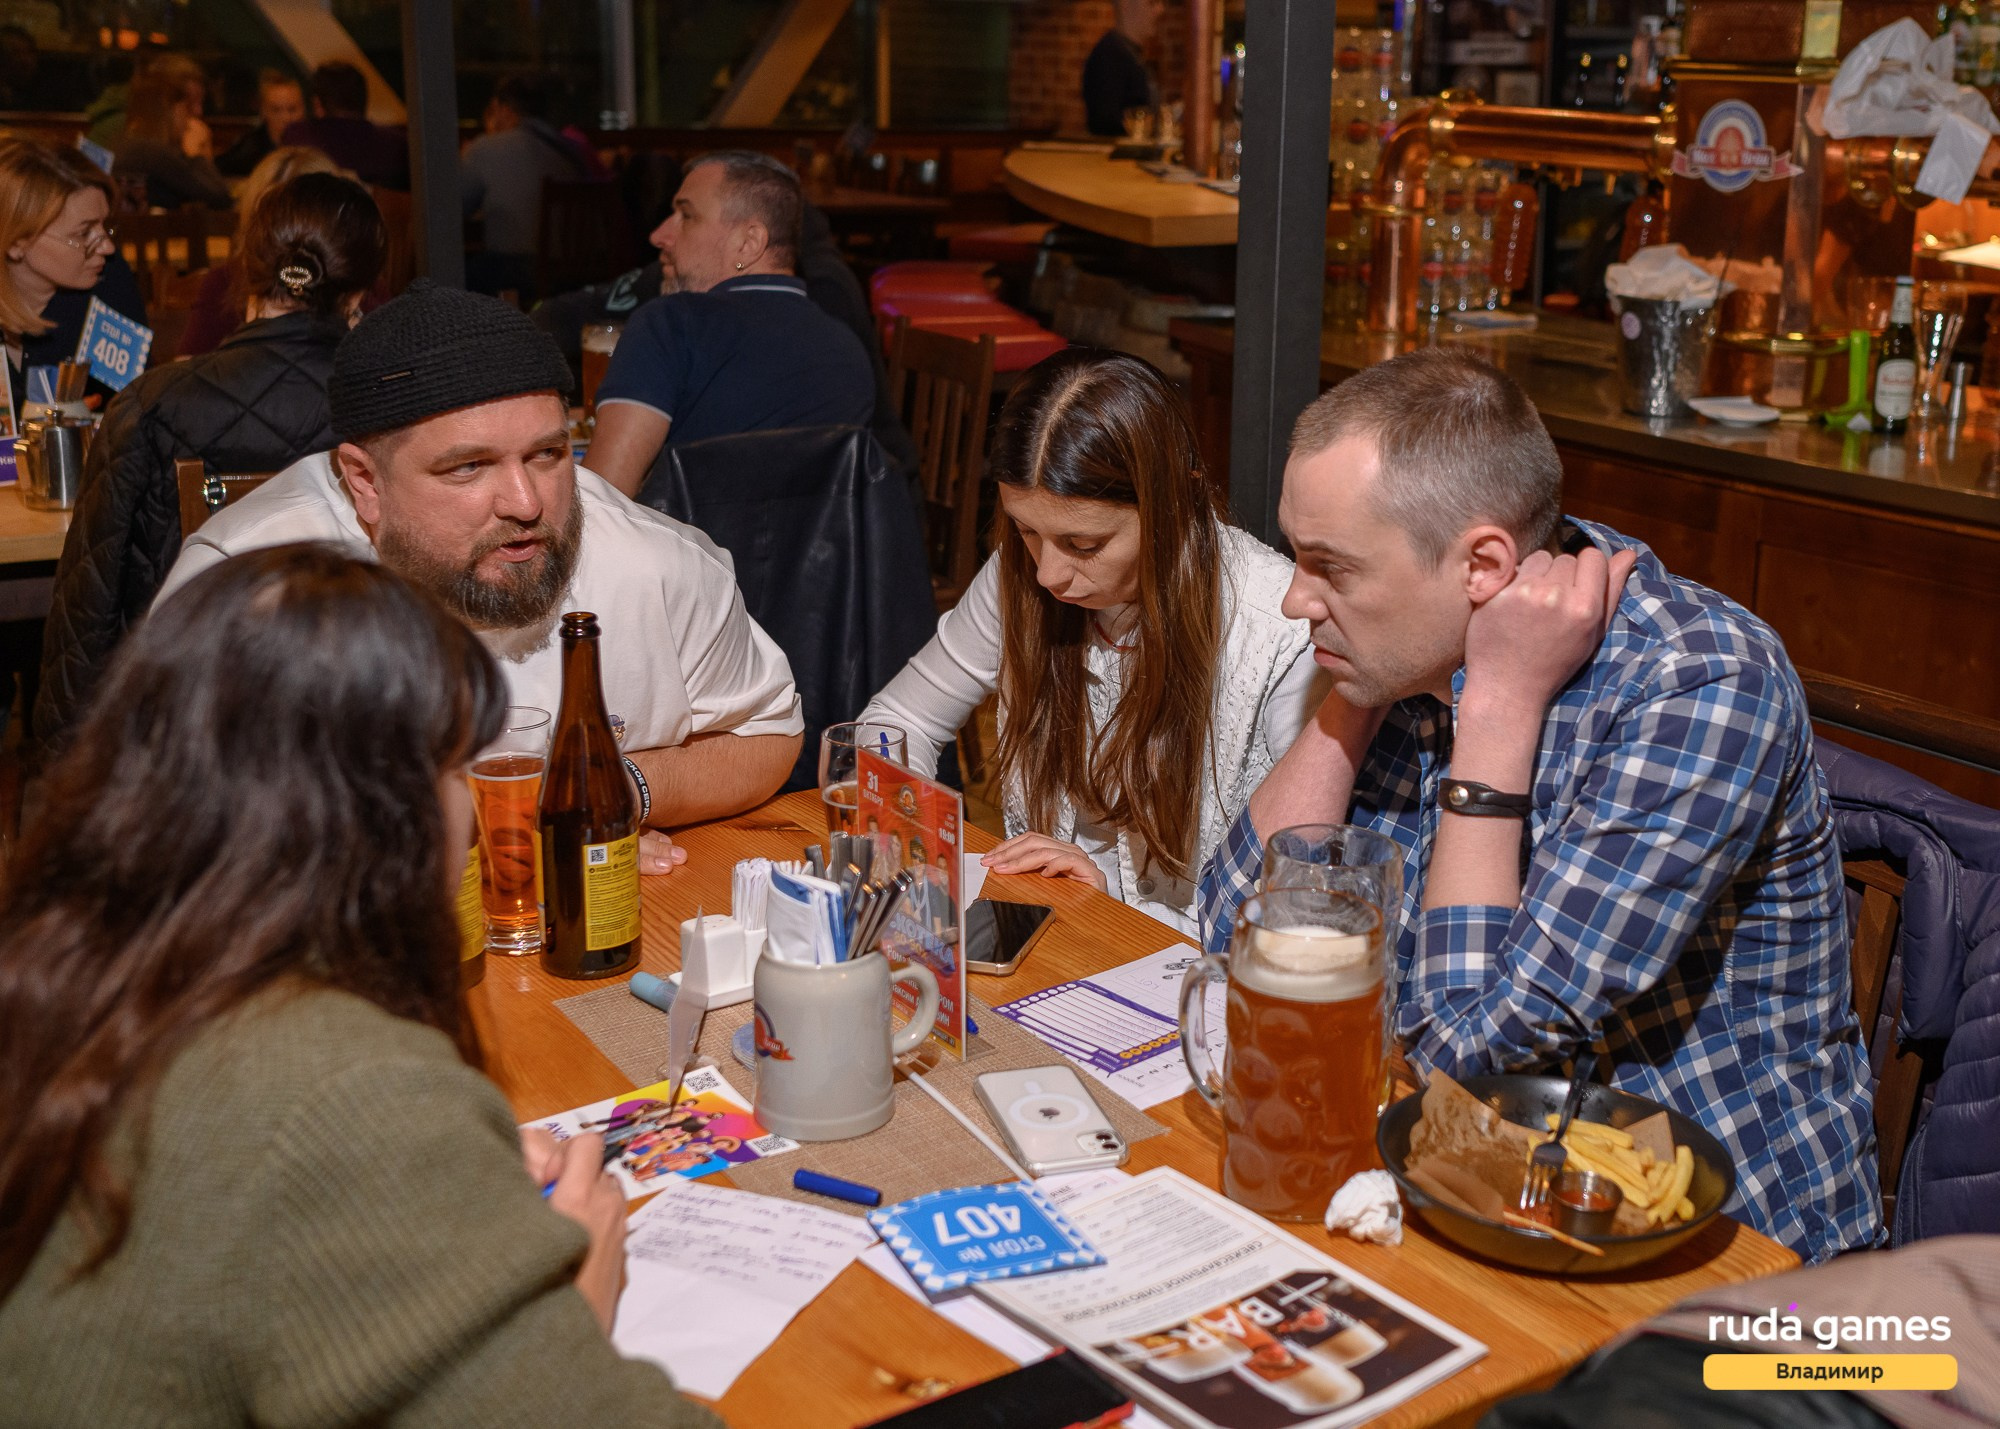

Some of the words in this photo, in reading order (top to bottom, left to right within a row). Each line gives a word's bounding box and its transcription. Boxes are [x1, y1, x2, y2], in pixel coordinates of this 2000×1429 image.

[93, 338, 130, 376] 408
[867, 770, 879, 793] 31
[932, 1202, 1021, 1247] 407
[957, 1244, 988, 1263] №
[987, 1234, 1047, 1259] СТОЛ
